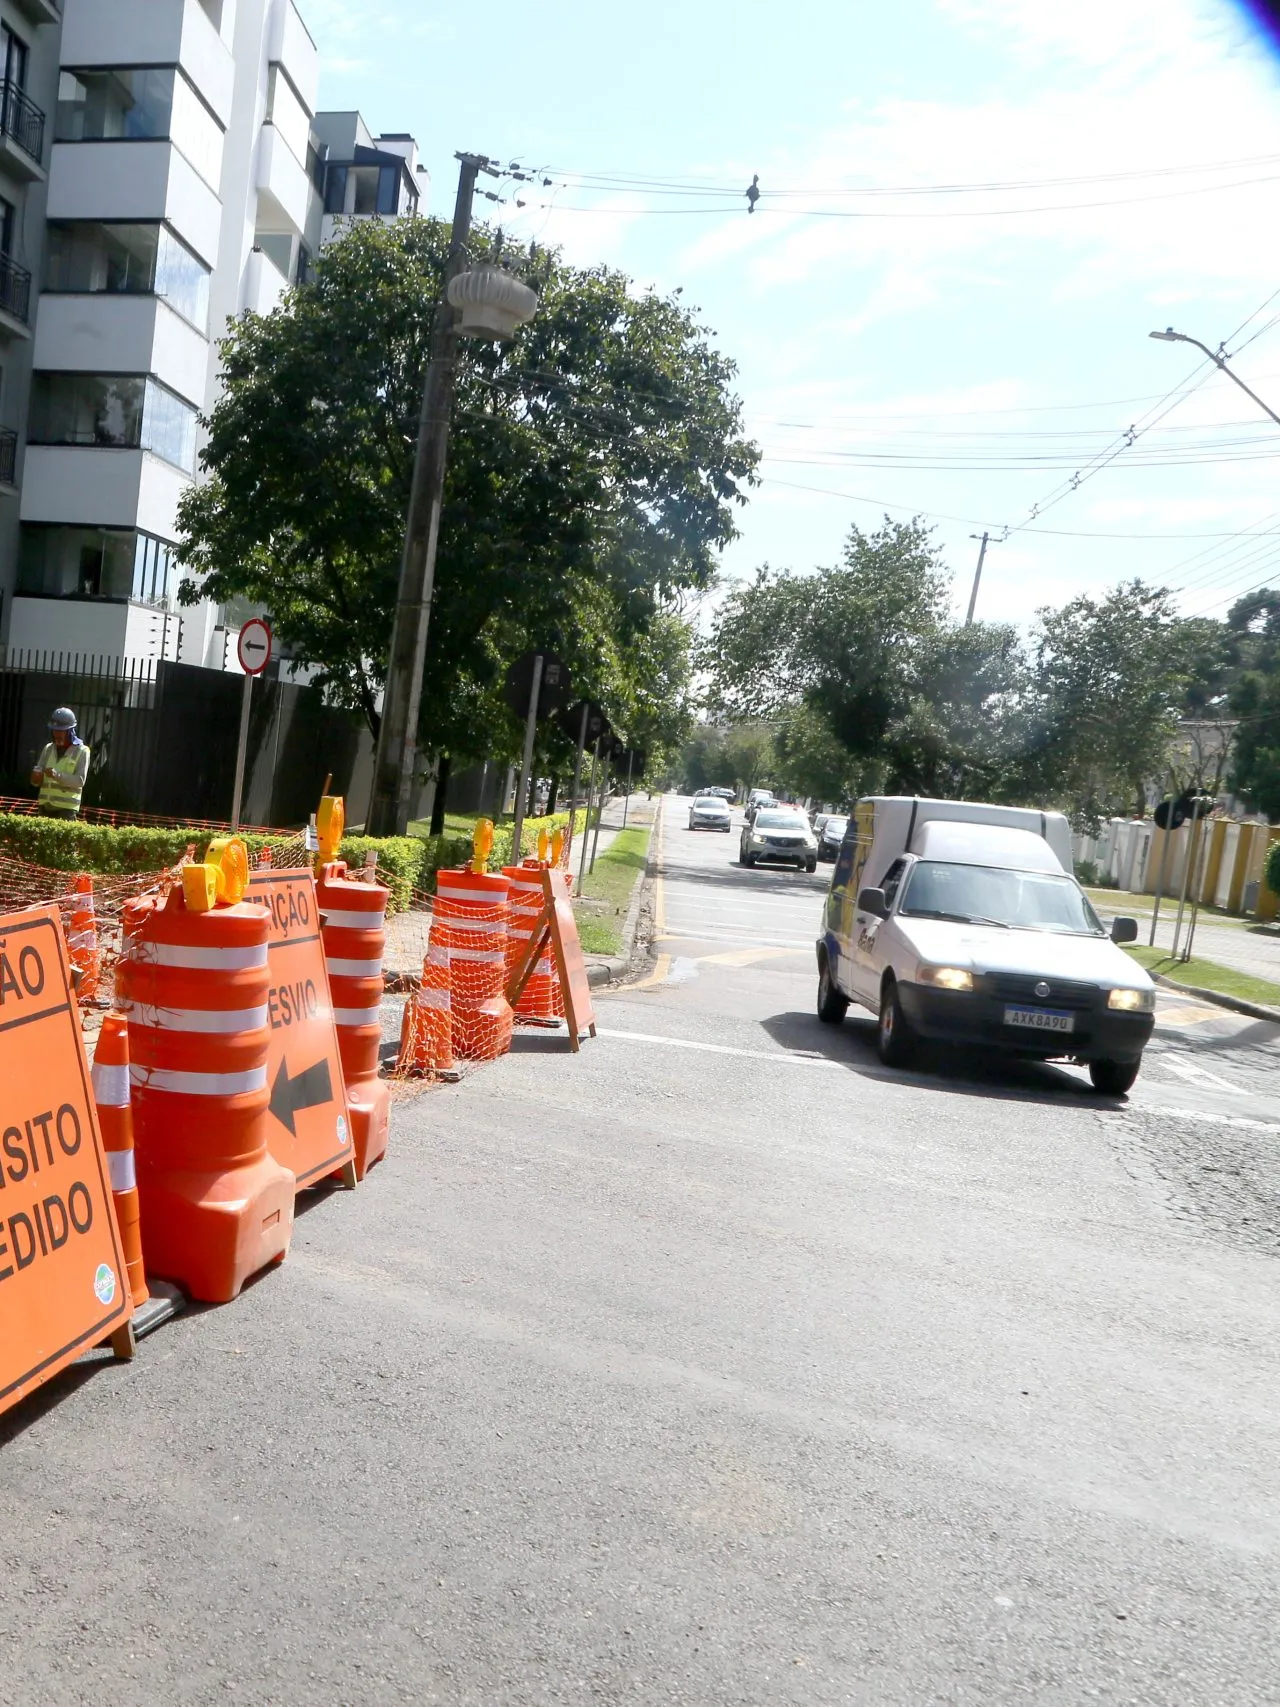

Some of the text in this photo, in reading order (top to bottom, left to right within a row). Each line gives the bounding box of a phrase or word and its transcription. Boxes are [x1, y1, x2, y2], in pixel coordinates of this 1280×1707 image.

[242, 884, 309, 937] NÇÃO
[267, 978, 318, 1029] ESVIO
[1011, 1011, 1068, 1029] AXK8A90
